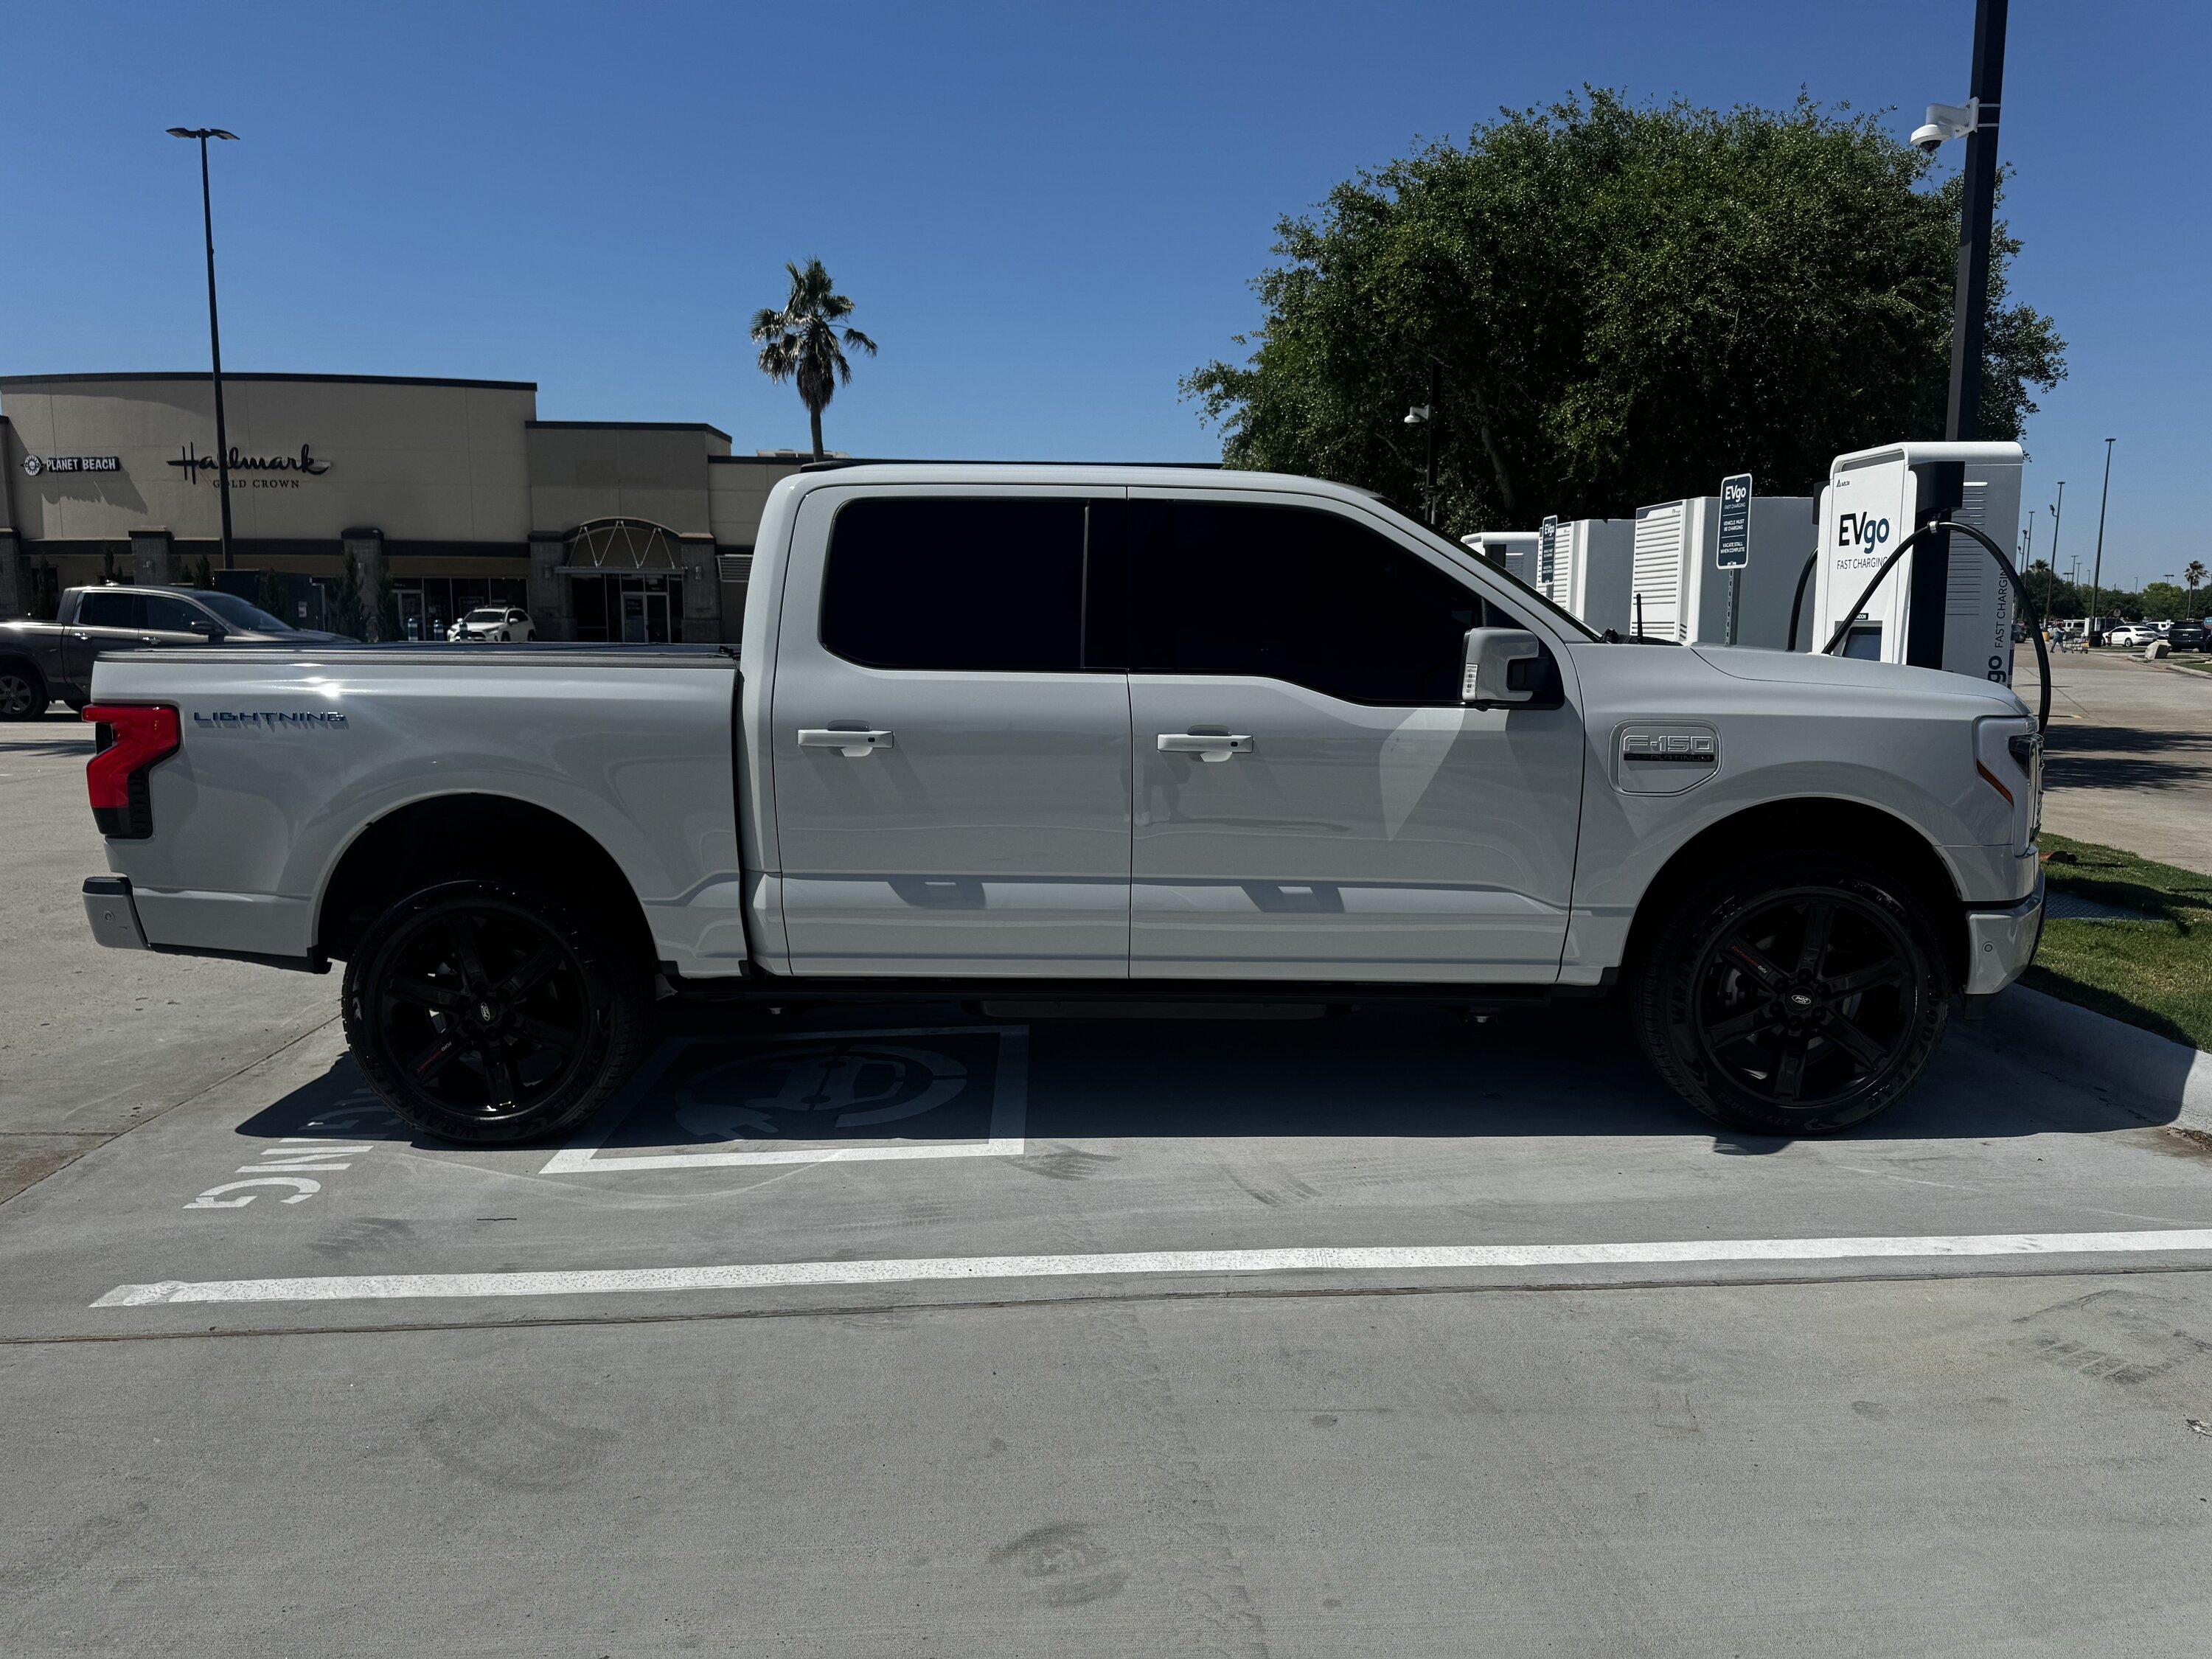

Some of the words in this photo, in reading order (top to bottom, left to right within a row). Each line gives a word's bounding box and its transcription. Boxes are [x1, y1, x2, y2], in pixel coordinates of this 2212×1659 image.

[46, 458, 78, 471] PLANET
[82, 457, 116, 470] BEACH
[166, 441, 329, 485] Halmark
[212, 480, 246, 488] GLD
[252, 479, 299, 488] CROWN
[1725, 484, 1746, 502] EVgo
[1838, 511, 1890, 554] EVgo
[1837, 559, 1852, 570] FAST
[1996, 568, 2008, 619] CHARGIN
[1994, 622, 2005, 648] FAST
[193, 711, 347, 725] LIGHTNING
[1623, 735, 1714, 753] F-150
